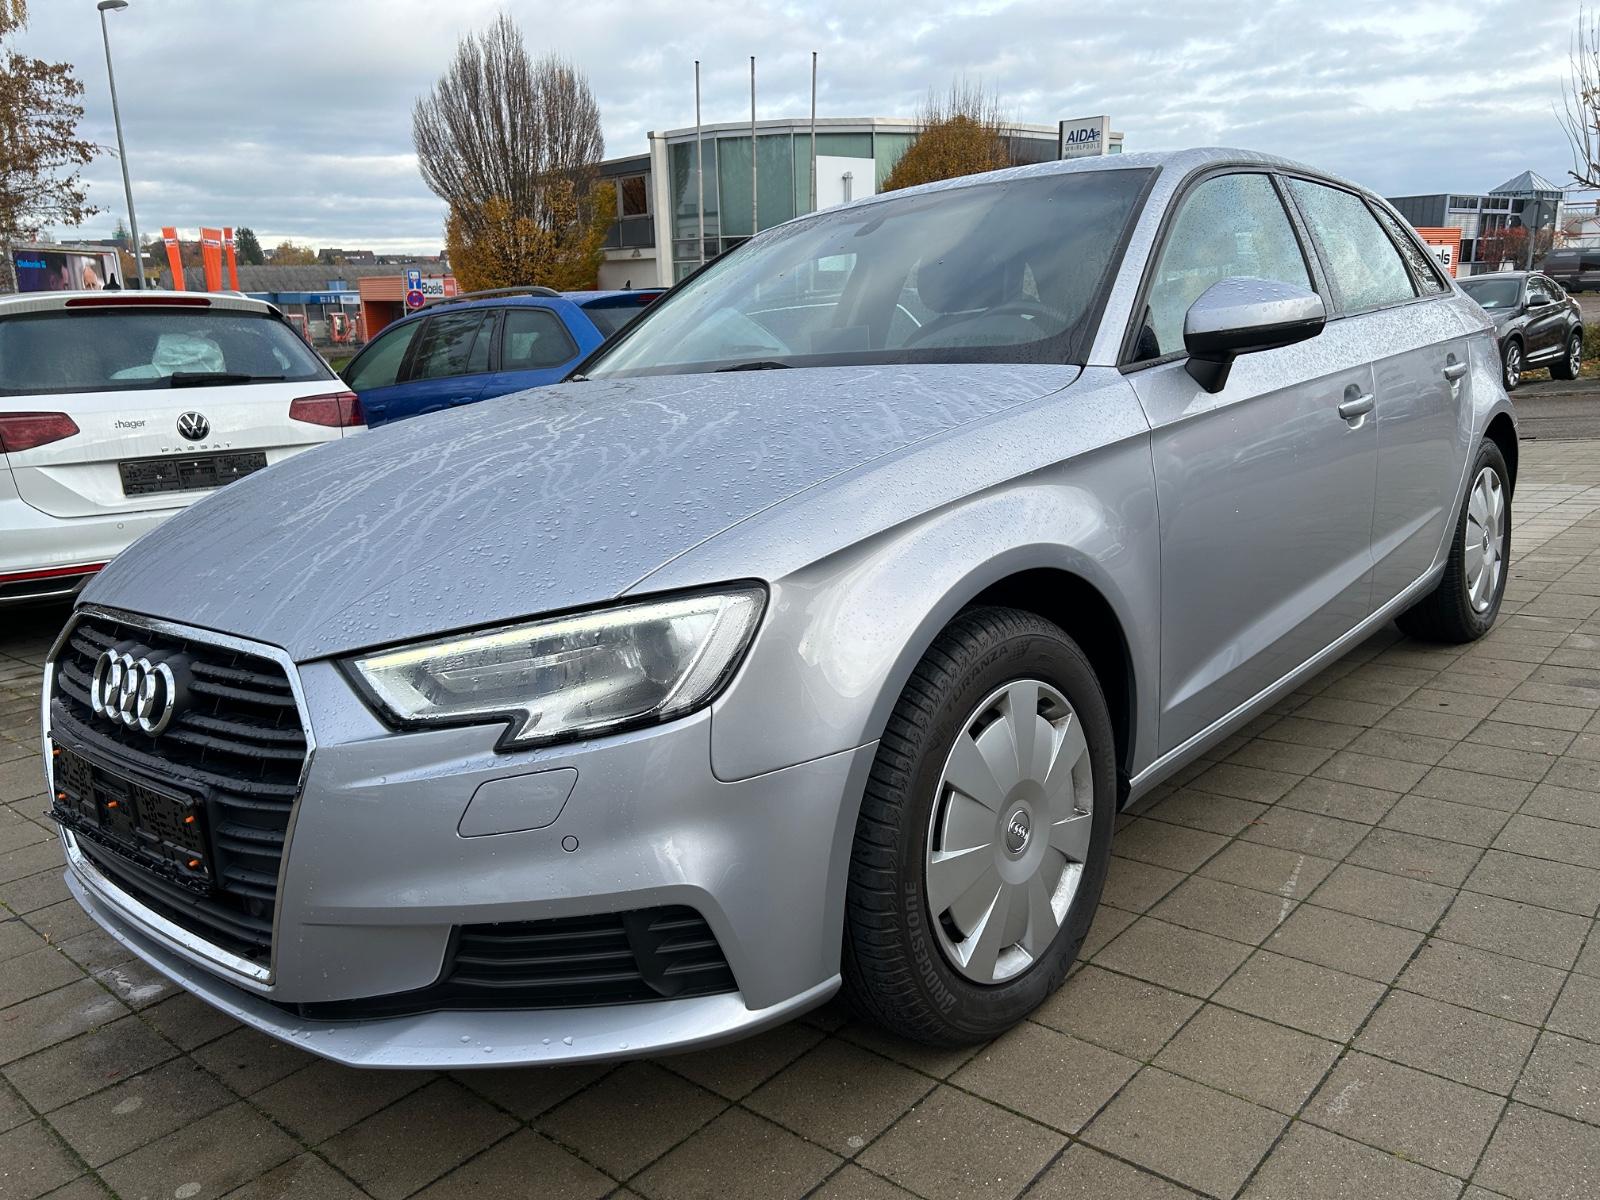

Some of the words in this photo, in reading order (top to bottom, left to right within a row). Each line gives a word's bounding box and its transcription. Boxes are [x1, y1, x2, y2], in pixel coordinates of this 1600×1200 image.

[1066, 128, 1096, 143] AIDA
[421, 282, 443, 294] Boels
[161, 442, 232, 453] PASSAT
[944, 646, 1009, 713] TURANZA
[905, 881, 957, 1015] BRIDGESTONE
